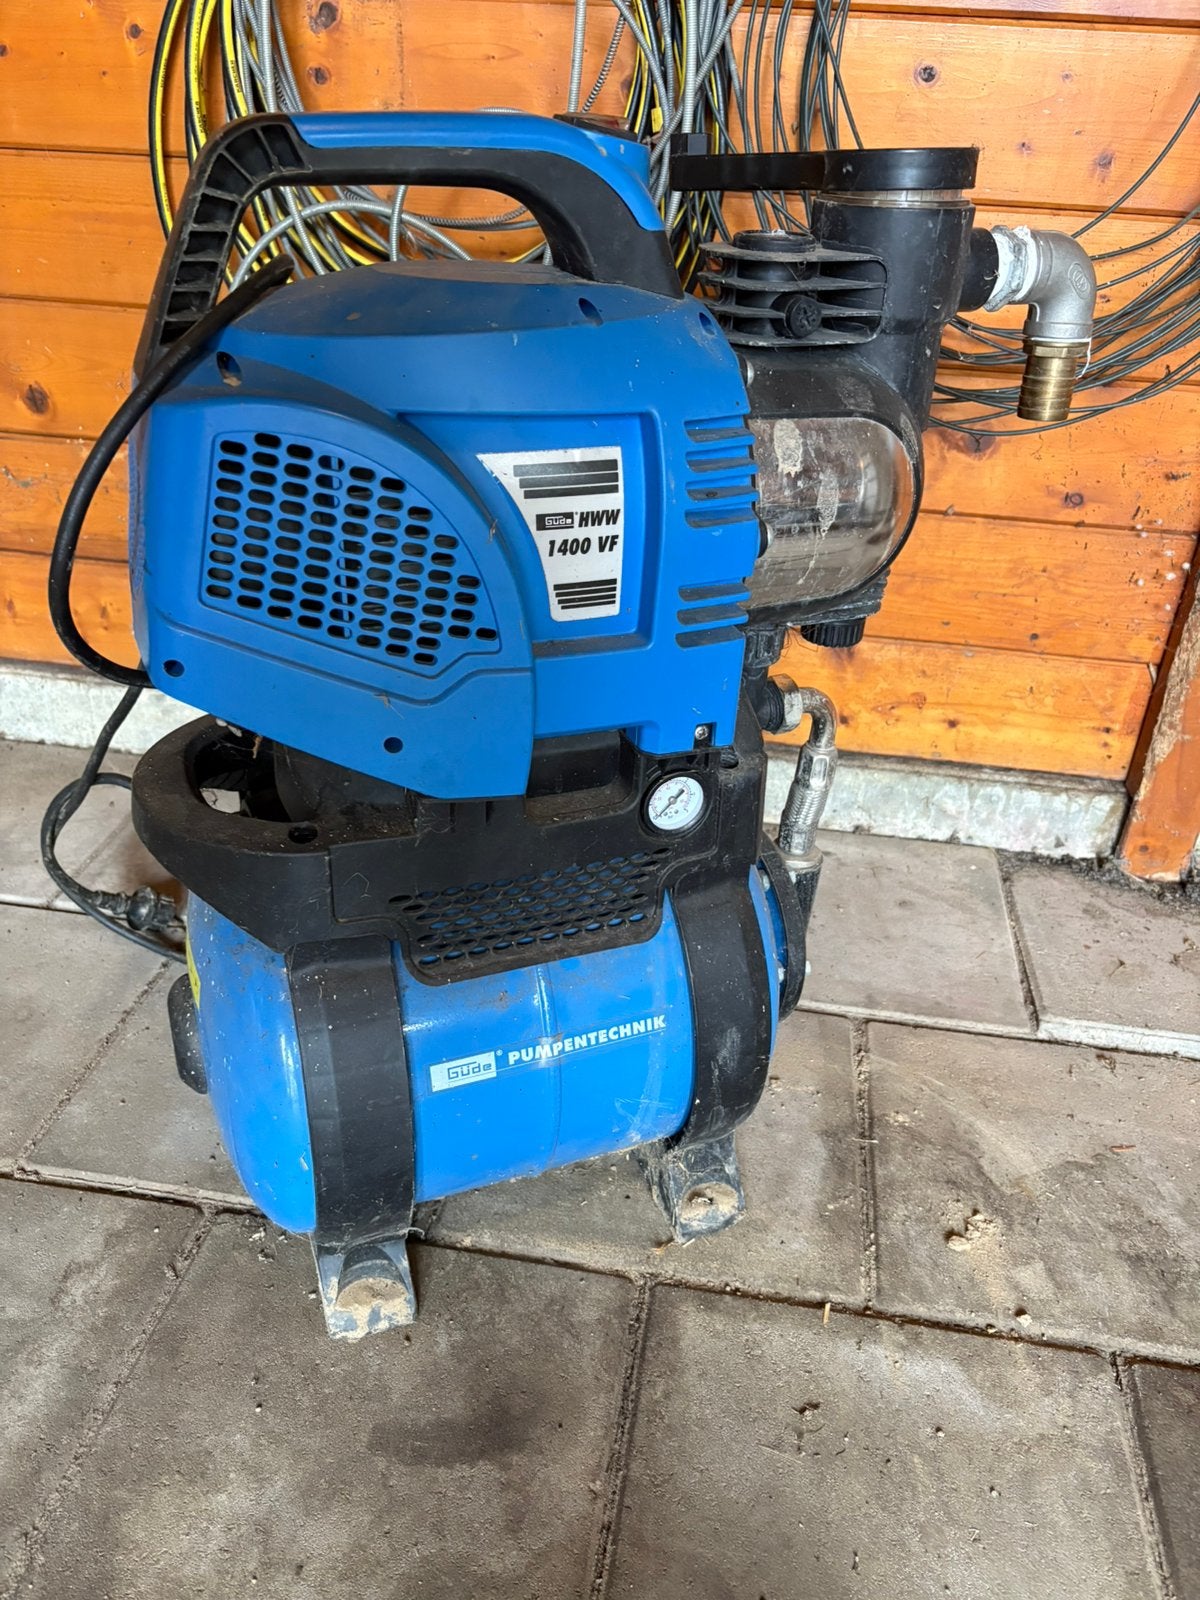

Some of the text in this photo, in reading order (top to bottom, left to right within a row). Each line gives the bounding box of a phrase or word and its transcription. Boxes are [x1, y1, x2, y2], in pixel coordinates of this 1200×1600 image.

[578, 508, 621, 528] HWW
[548, 534, 619, 557] 1400 VF
[508, 1015, 667, 1065] PUMPENTECHNIK
